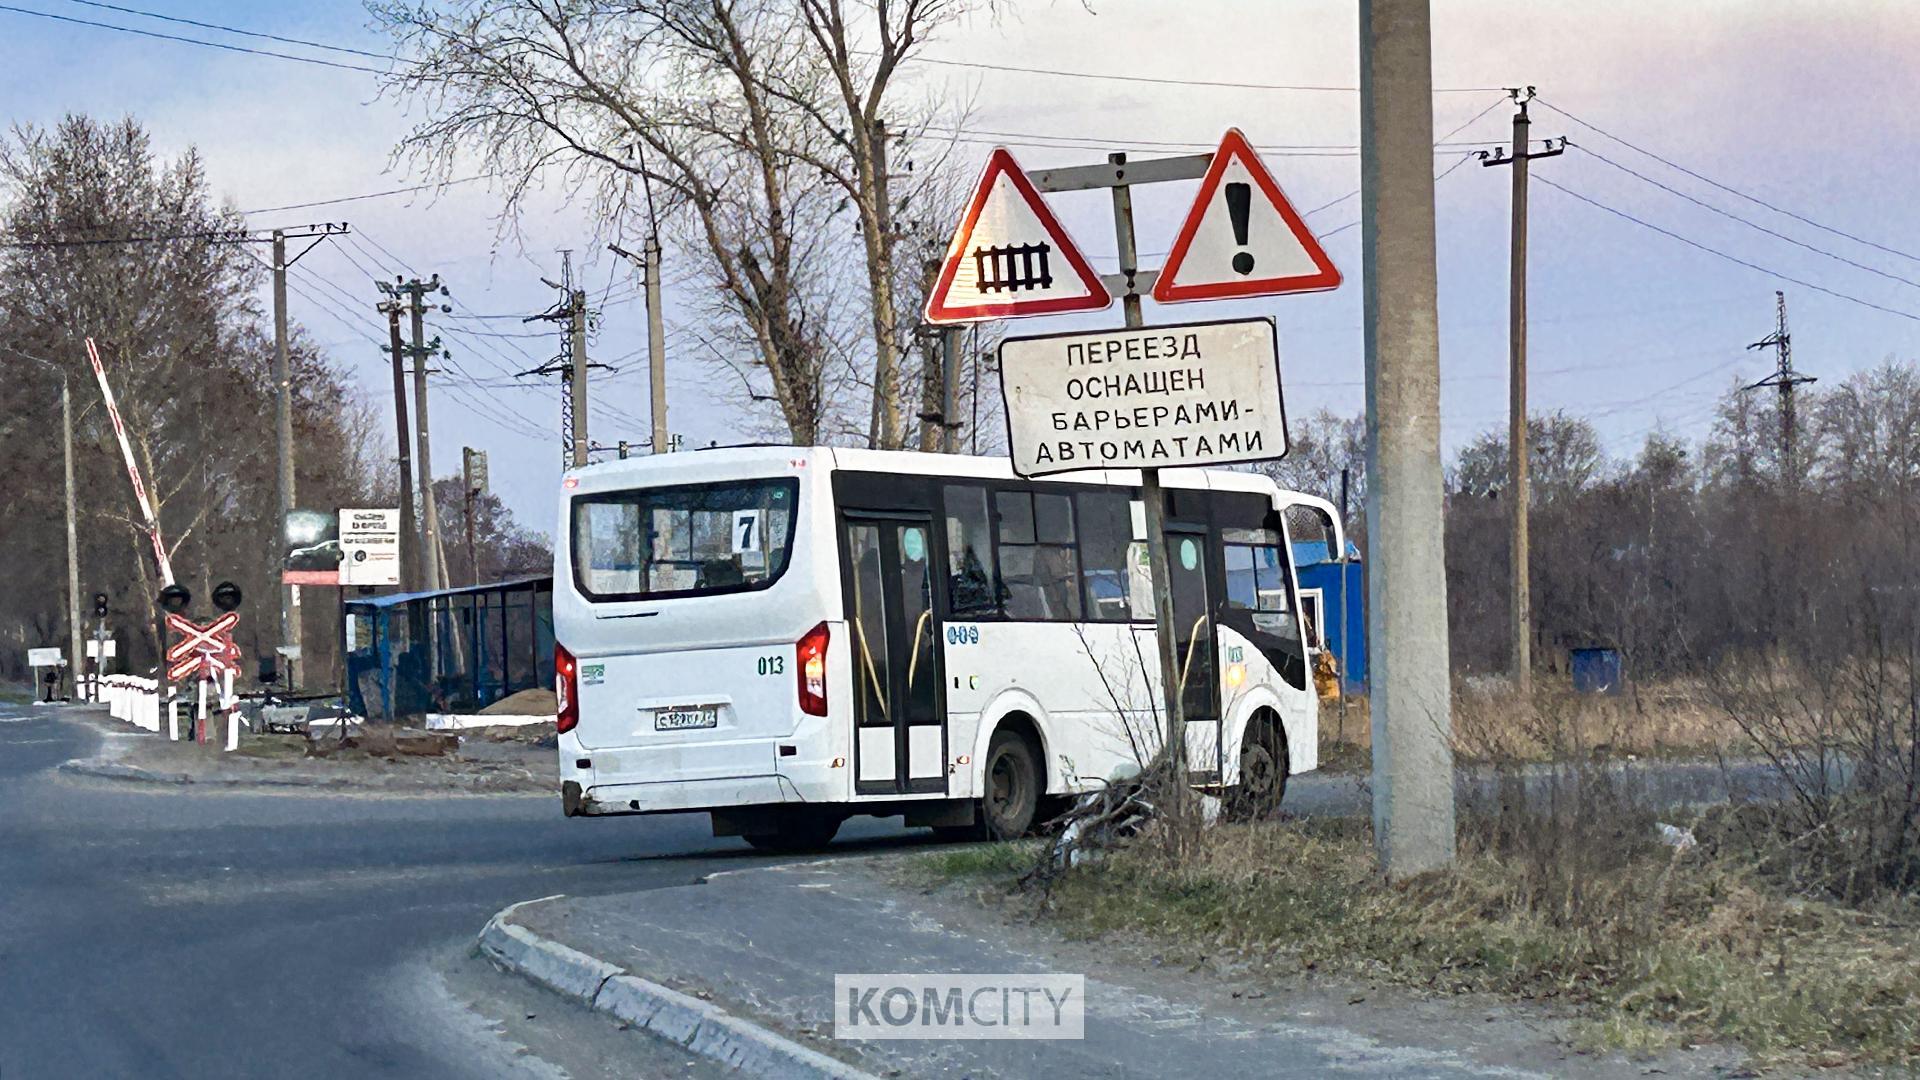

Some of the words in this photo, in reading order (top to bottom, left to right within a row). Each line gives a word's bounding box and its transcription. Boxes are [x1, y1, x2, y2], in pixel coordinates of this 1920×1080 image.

[1067, 333, 1201, 366] ПЕРЕЕЗД
[1067, 368, 1205, 400] ОСНАЩЕН
[1052, 400, 1254, 431] БАРЬЕРАМИ-
[1035, 431, 1263, 464] АВТОМАТАМИ
[738, 516, 755, 549] 7
[758, 655, 784, 676] 013
